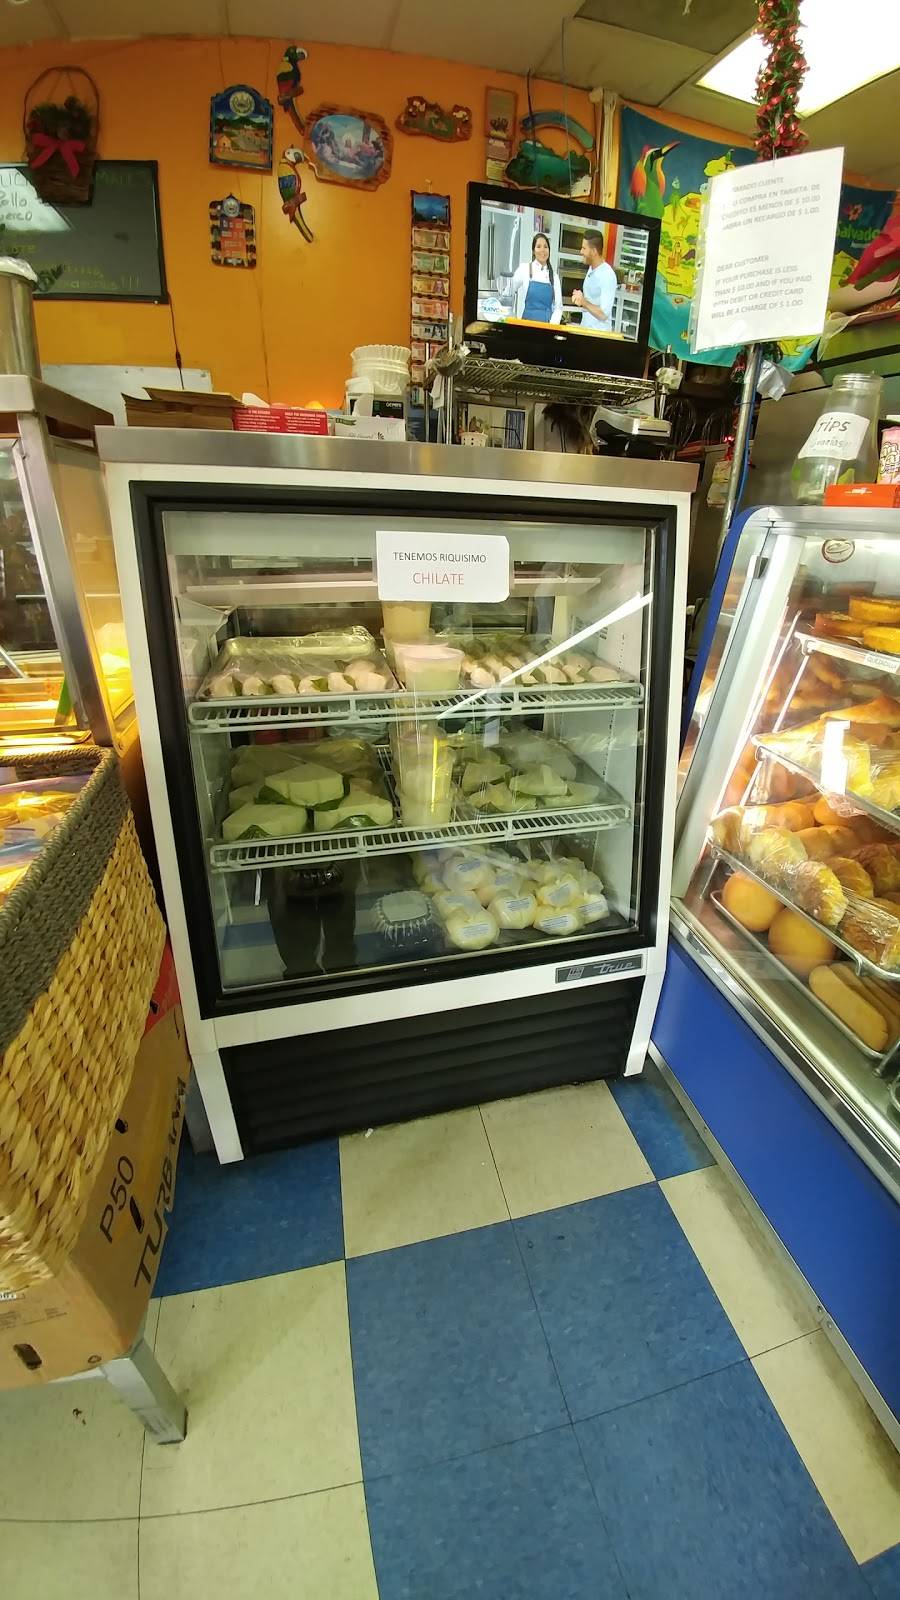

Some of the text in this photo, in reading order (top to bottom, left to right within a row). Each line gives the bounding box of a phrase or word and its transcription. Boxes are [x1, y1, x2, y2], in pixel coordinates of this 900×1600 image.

[758, 177, 784, 189] CLIENTE
[739, 193, 767, 205] COMPRA
[769, 190, 779, 198] EN
[780, 185, 808, 196] TARJETA
[811, 183, 820, 191] DE
[749, 205, 757, 213] ES
[758, 201, 783, 211] MENOS
[784, 199, 793, 207] DE
[0, 211, 33, 223] uerco
[742, 217, 753, 226] UN
[754, 211, 786, 223] RECARGO
[787, 209, 796, 217] DE
[837, 224, 881, 240] alvado
[716, 255, 769, 272] DEAR CUSTOMER
[722, 275, 739, 285] YOUR
[739, 268, 774, 281] PURCHASE
[782, 264, 799, 273] LESS
[714, 288, 731, 297] THAN
[755, 279, 771, 288] AND
[779, 276, 794, 285] YOU
[795, 273, 812, 283] PAID
[729, 295, 747, 305] DEBIT
[748, 293, 758, 301] OR
[759, 289, 784, 300] CREDIT
[711, 309, 725, 319] WILL
[726, 308, 735, 316] BE
[735, 306, 740, 314] A
[741, 303, 767, 313] CHARGE
[768, 302, 778, 310] OF
[392, 551, 487, 564] TENEMOS RIQUISIMO
[412, 572, 465, 585] CHILATE
[100, 1155, 135, 1244] P50
